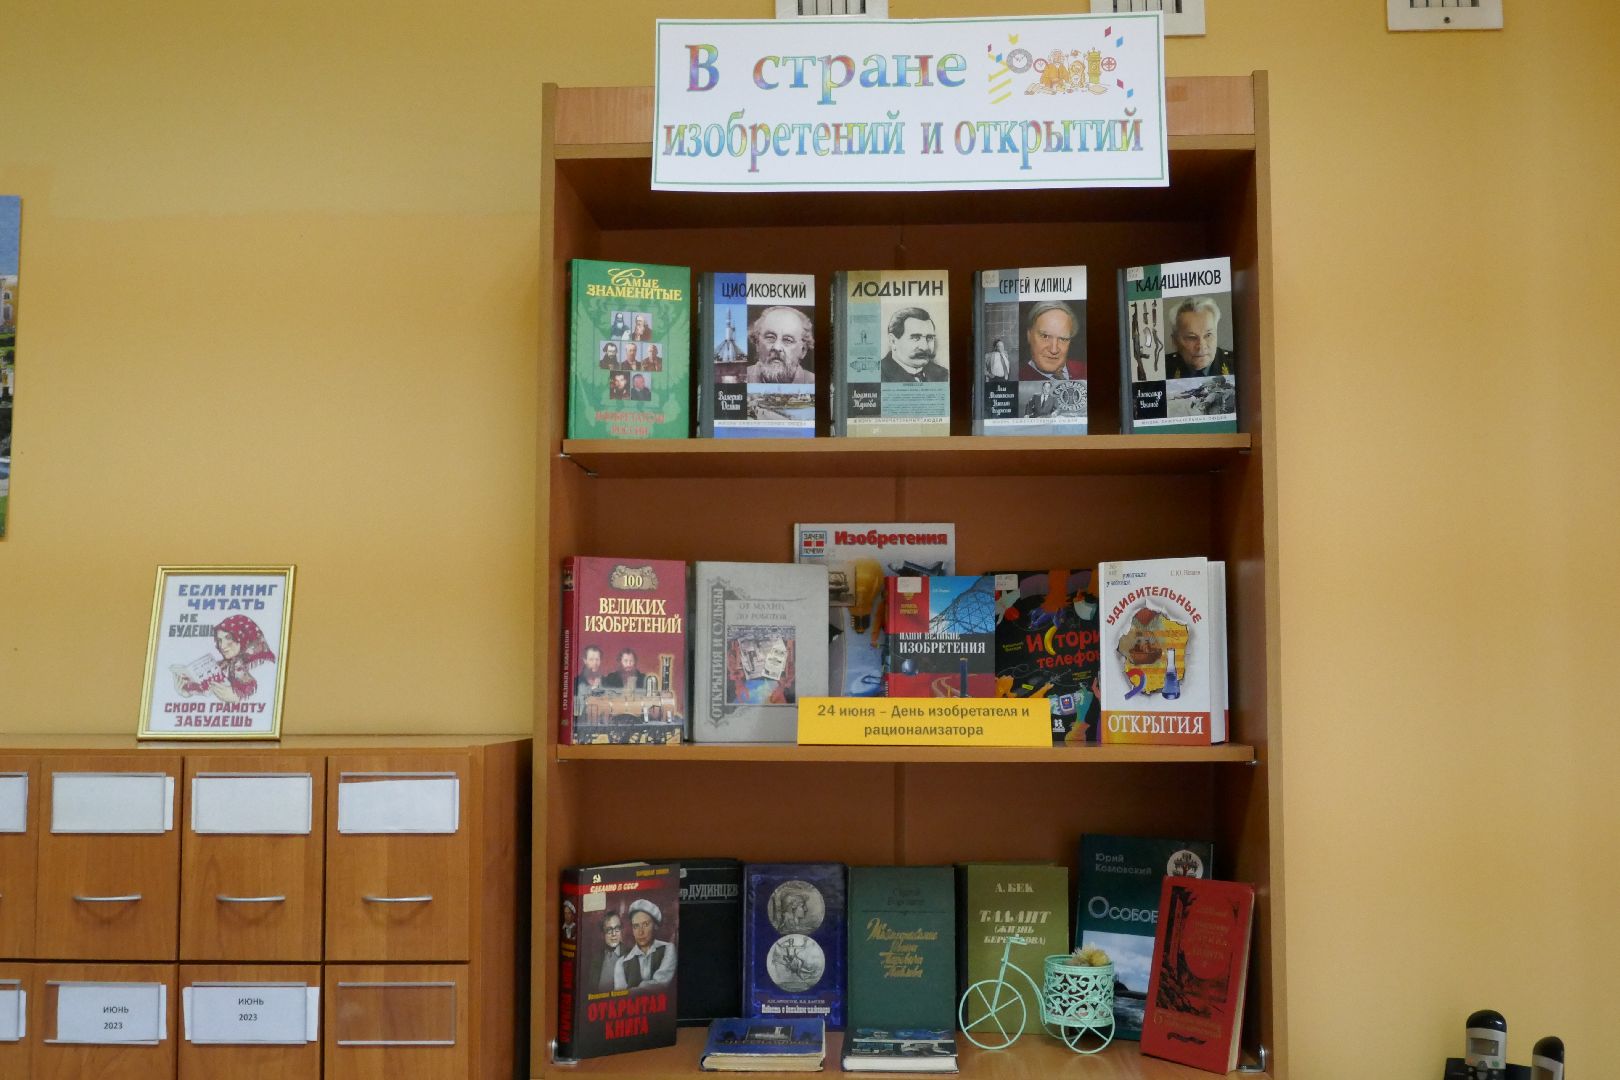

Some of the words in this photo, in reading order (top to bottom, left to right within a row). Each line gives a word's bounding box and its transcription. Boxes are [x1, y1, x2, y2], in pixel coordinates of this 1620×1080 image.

[684, 43, 720, 92] В
[753, 53, 967, 105] стране
[662, 109, 905, 172] изобретений
[921, 121, 944, 155] и
[954, 107, 1144, 170] открытий
[851, 280, 944, 297] ЛОДЫГИН
[1000, 277, 1030, 294] СЕРГЕЙ
[1034, 277, 1072, 294] КАПИЦА
[1136, 270, 1222, 292] КАЛАШНИКОВ
[586, 284, 682, 300] ЗНАМЕНИТЫЕ
[722, 281, 807, 298] ЦИОЛКОВСКИЙ
[834, 529, 948, 549] Изобретения
[623, 575, 643, 587] 100
[178, 584, 225, 596] ЕСЛИ
[231, 584, 278, 596] КНИГ
[187, 598, 265, 610] ЧИТАТЬ
[599, 598, 666, 615] ВЕЛИКИХ
[712, 588, 723, 635] СУДЬБЫ
[1106, 586, 1202, 625] УДИВИТЕЛЬНЫЕ
[179, 613, 199, 622] НЕ
[585, 614, 682, 633] ИЗОБРЕТЕНИЙ
[169, 625, 217, 638] БУДЕШЬ
[900, 632, 921, 640] НАШИ
[712, 639, 722, 647] И
[900, 641, 986, 654] ИЗОБРЕТЕНИЯ
[1026, 628, 1099, 655] Истори
[711, 651, 723, 718] ОТКРЫТИЯ
[164, 702, 205, 713] СКОРО
[209, 702, 266, 713] ГРАМОТУ
[817, 705, 836, 716] 24
[839, 707, 875, 717] июня
[891, 705, 924, 718] День
[928, 705, 1017, 719] изобретателя
[1022, 708, 1030, 717] и
[174, 715, 253, 727] ЗАБУДЕШЬ
[1107, 715, 1204, 735] ОТКРЫТИЯ
[864, 725, 984, 737] рационализатора
[1096, 853, 1124, 863] Юрий
[689, 884, 739, 900] ДУДИНЦЕВ
[1008, 883, 1034, 893] БЕК
[980, 910, 1051, 924] ТАЛАНТ
[984, 936, 1046, 945] БЕРЕОВА)
[588, 992, 667, 1022] ОТКРЫТАЯ
[239, 1013, 258, 1021] 2023
[104, 1022, 123, 1030] 2023
[605, 1015, 649, 1040] КНИГА
